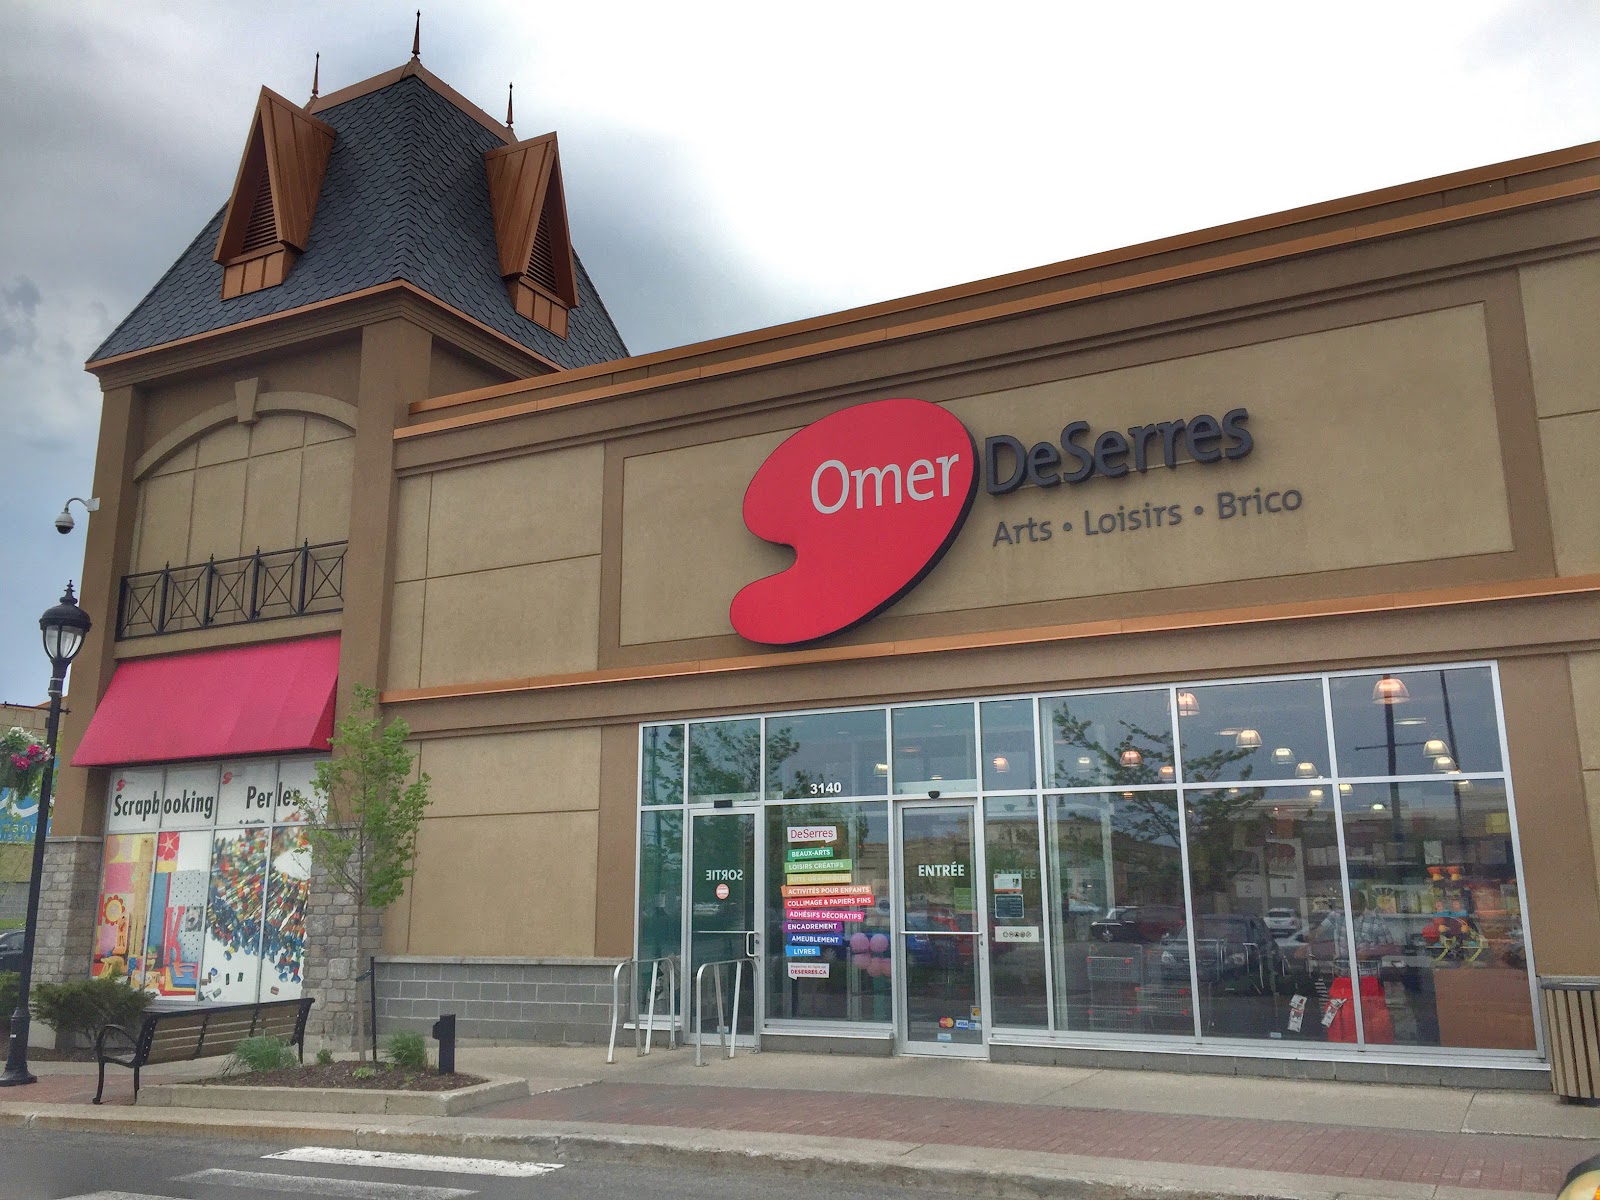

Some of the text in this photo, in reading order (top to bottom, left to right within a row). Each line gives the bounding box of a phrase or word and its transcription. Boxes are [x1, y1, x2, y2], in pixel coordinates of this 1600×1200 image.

[811, 407, 1254, 514] Omer DeSerres
[993, 487, 1302, 547] Arts Loisirs Brico
[810, 781, 842, 795] 3140
[246, 782, 301, 809] Perles
[113, 789, 214, 822] Scrapbooking
[790, 828, 834, 839] DeSerres
[791, 849, 831, 858] BEAUX-ARTS
[788, 861, 844, 871] LOISIRS CRÉATIFS
[918, 861, 965, 877] ENTRÉE
[788, 887, 820, 895] ACTIVITÉS
[787, 899, 822, 907] COLLIMAGE
[789, 910, 862, 920] ADHÉSIFS DÉCORATIFS
[791, 935, 839, 944] AMEUBLEMENT
